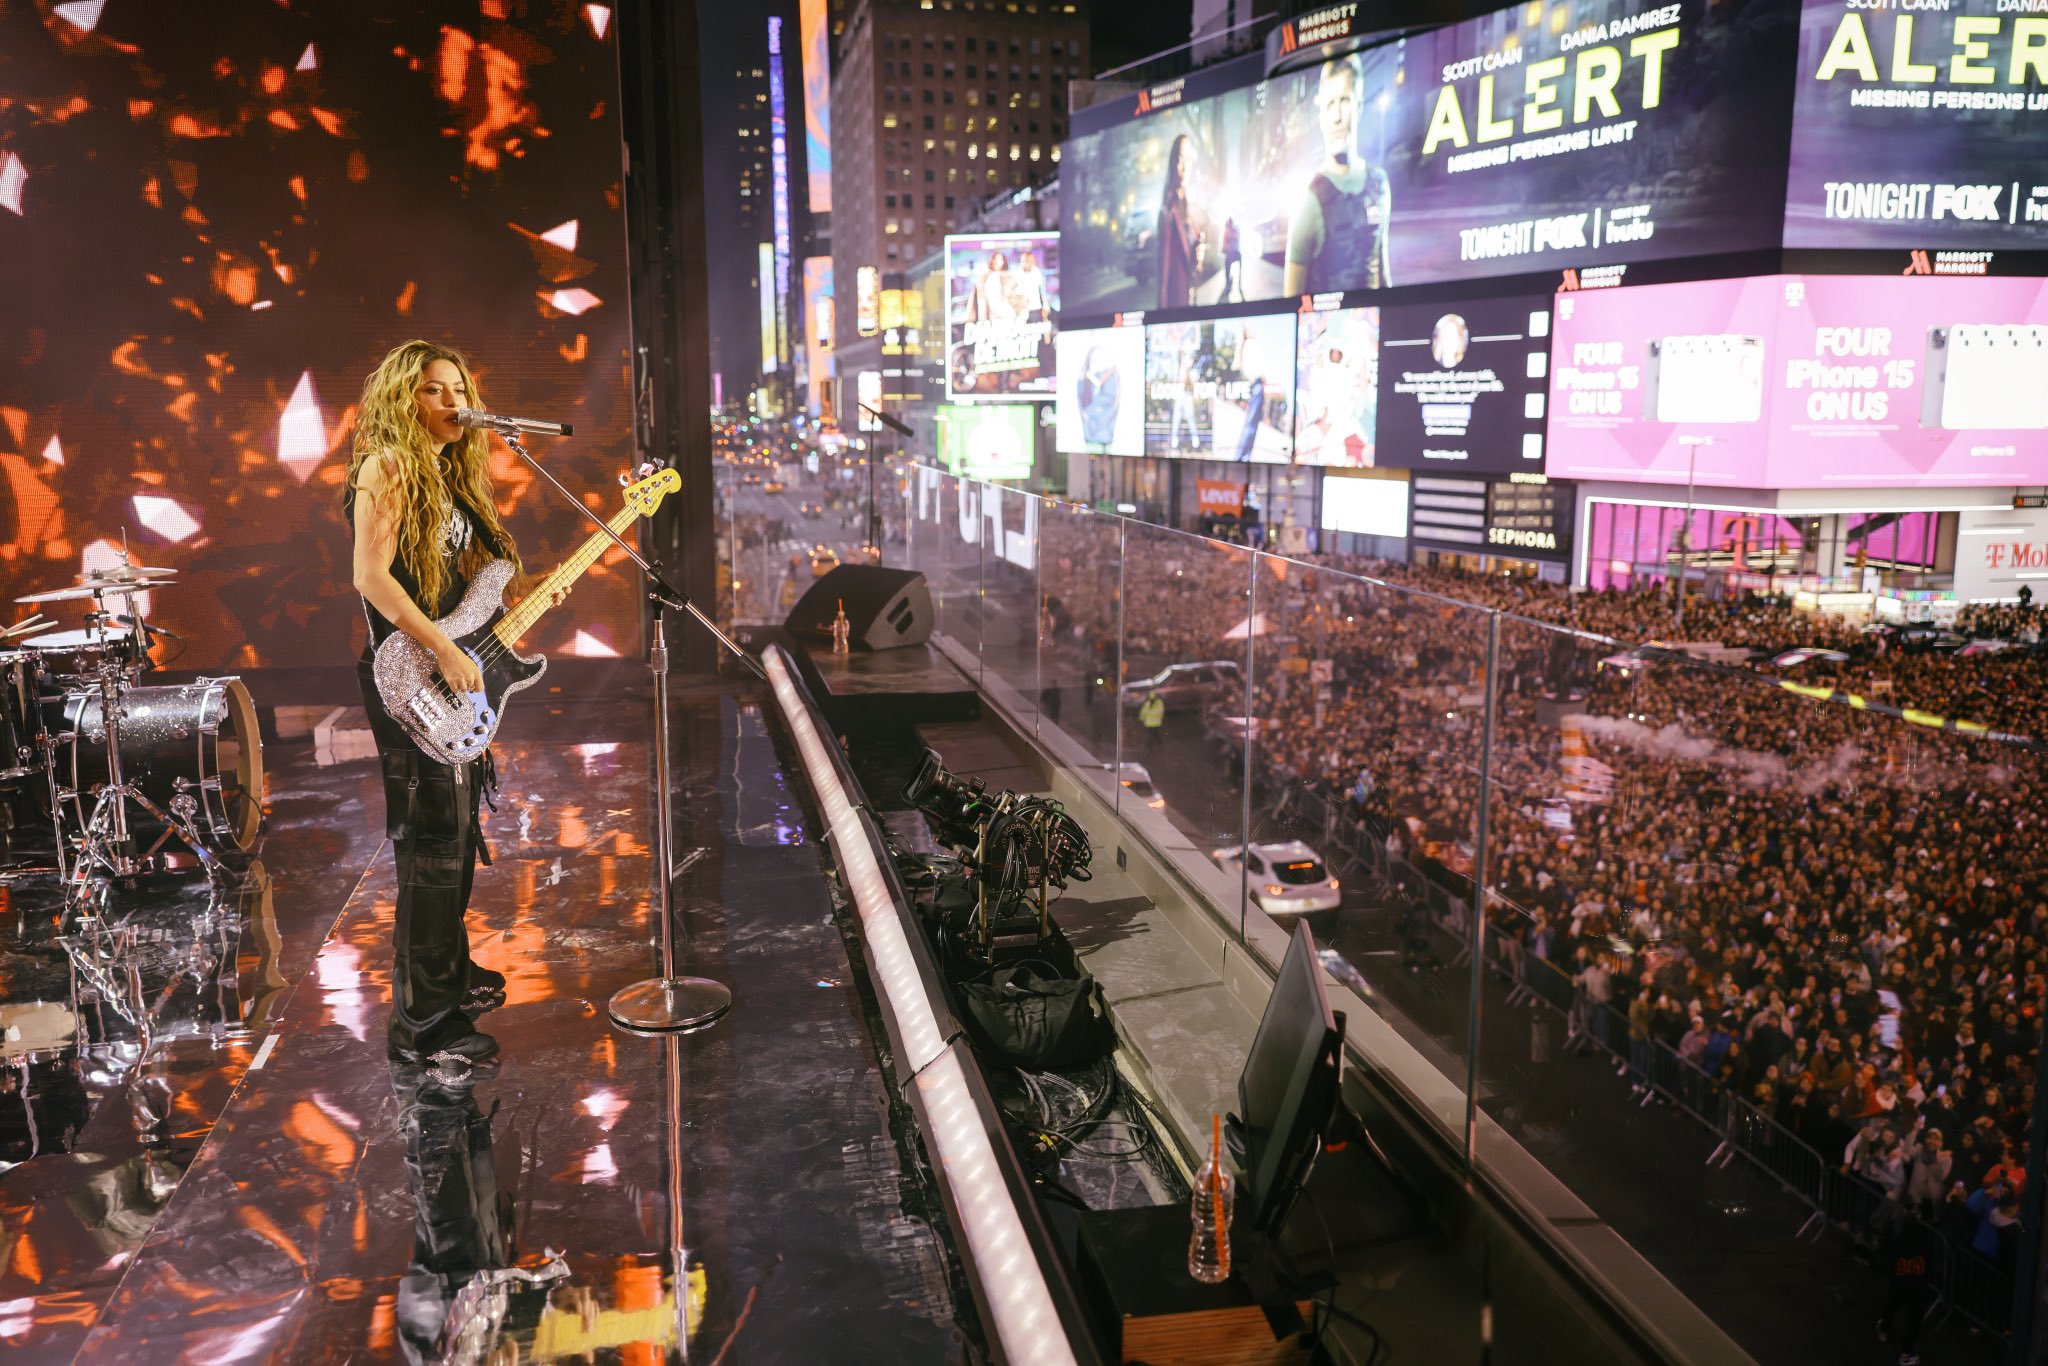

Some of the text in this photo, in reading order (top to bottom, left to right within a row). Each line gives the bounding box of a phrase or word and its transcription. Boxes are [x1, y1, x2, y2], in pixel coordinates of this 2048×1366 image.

[1560, 3, 1682, 51] DANIA RAMIREZ
[1442, 47, 1523, 82] SCOTT CAAN
[1421, 27, 1680, 155] ALERT
[1851, 89, 1930, 108] MISSING
[1933, 91, 2025, 110] PERSONS
[1447, 120, 1637, 173] MISSING PERSONS UNIT
[1824, 182, 2003, 221] TONIGHT FOX
[1460, 212, 1588, 261] TONIGHT FOX
[1606, 217, 1654, 244] hulu
[1935, 262, 1986, 274] MARQUIS
[1936, 251, 1993, 263] MARRIOTT
[1573, 341, 1623, 366] FOUR
[1815, 327, 1891, 356] FOUR
[1556, 365, 1640, 390] iPhone 15
[1786, 359, 1915, 389] iPhone 15
[1568, 391, 1623, 414] ON US
[1806, 391, 1889, 421] ON US
[1489, 527, 1556, 549] SEPHORA
[1003, 823, 1031, 837] SCORPIO
